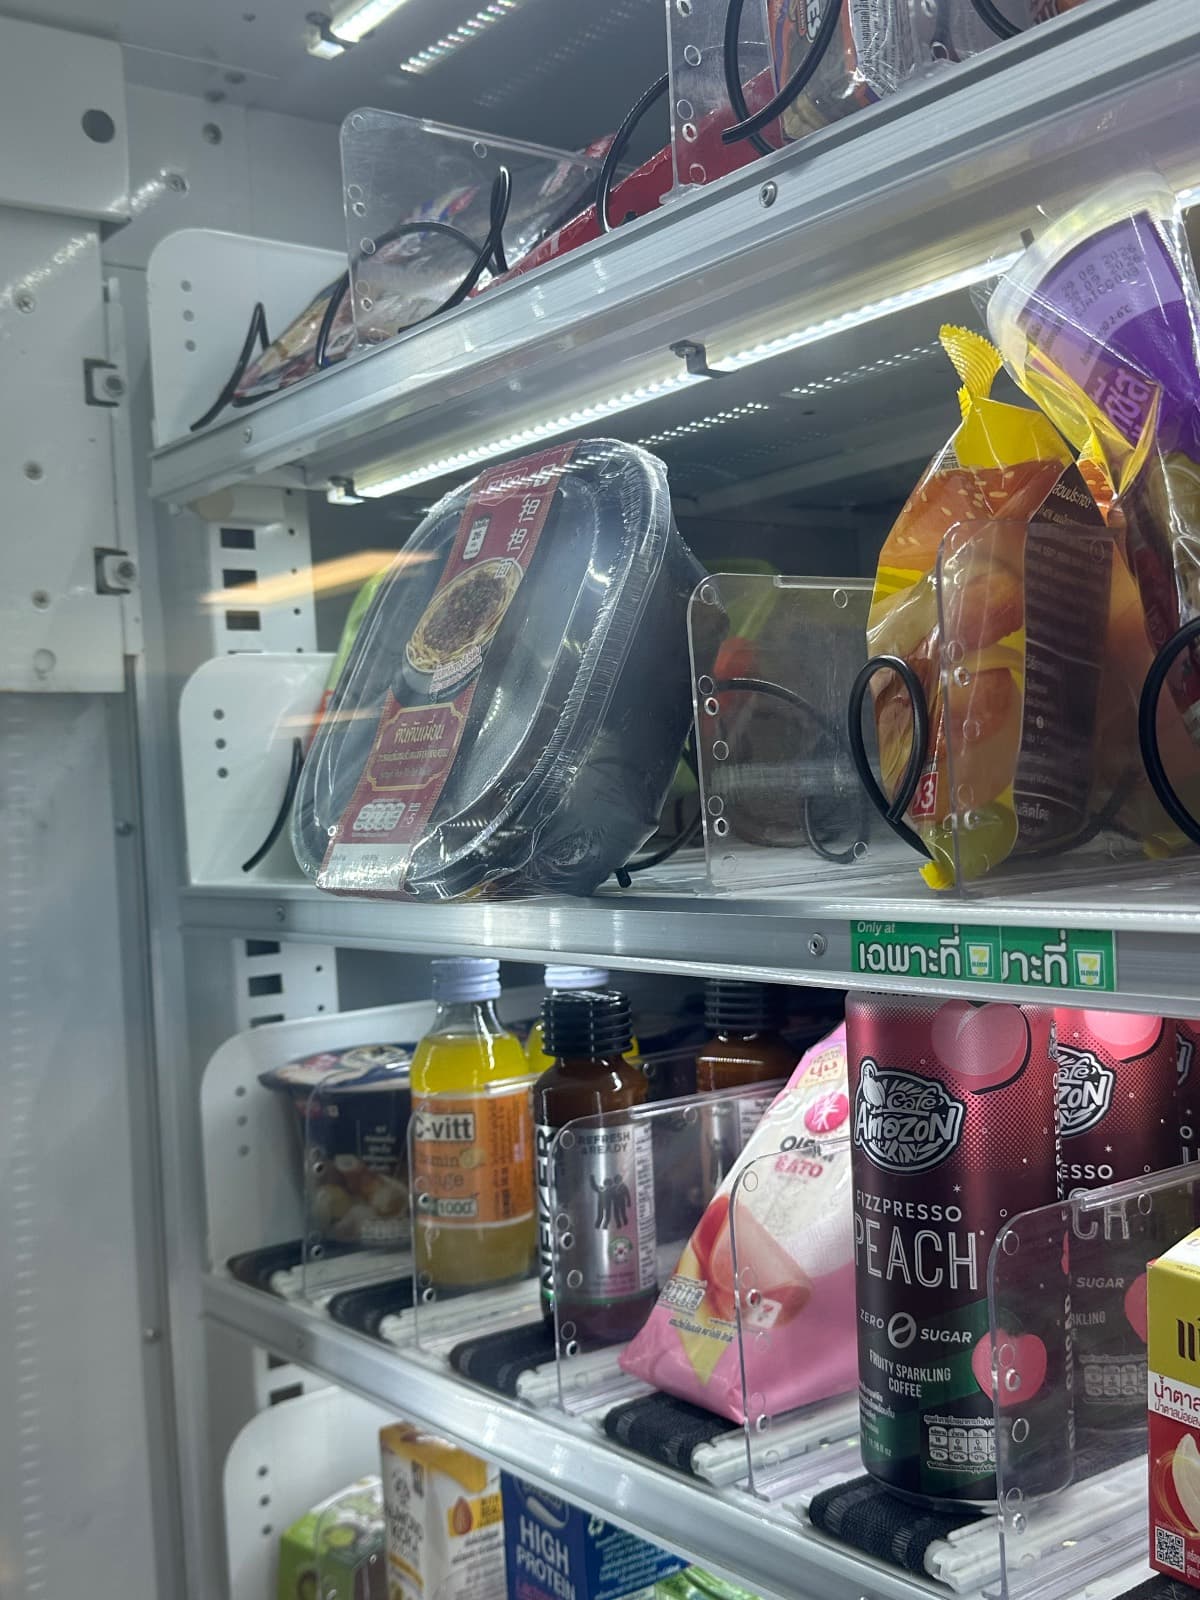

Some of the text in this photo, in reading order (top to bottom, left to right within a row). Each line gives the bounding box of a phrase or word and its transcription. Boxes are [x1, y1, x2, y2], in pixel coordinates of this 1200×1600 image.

[857, 921, 896, 936] Only at
[859, 924, 962, 976] เฉพาะที่
[414, 1116, 472, 1140] C-vitt
[857, 1190, 962, 1222] FIZZPRESSO
[855, 1211, 978, 1290] PEACH
[1076, 1277, 1124, 1289] SUGAR
[860, 1309, 885, 1329] ZERO
[920, 1328, 972, 1343] SUGAR
[869, 1349, 951, 1382] FRUITY SPARKLING
[888, 1377, 922, 1398] COFFEE
[519, 1514, 570, 1576] HIGH
[516, 1544, 576, 1600] PROTEIN
